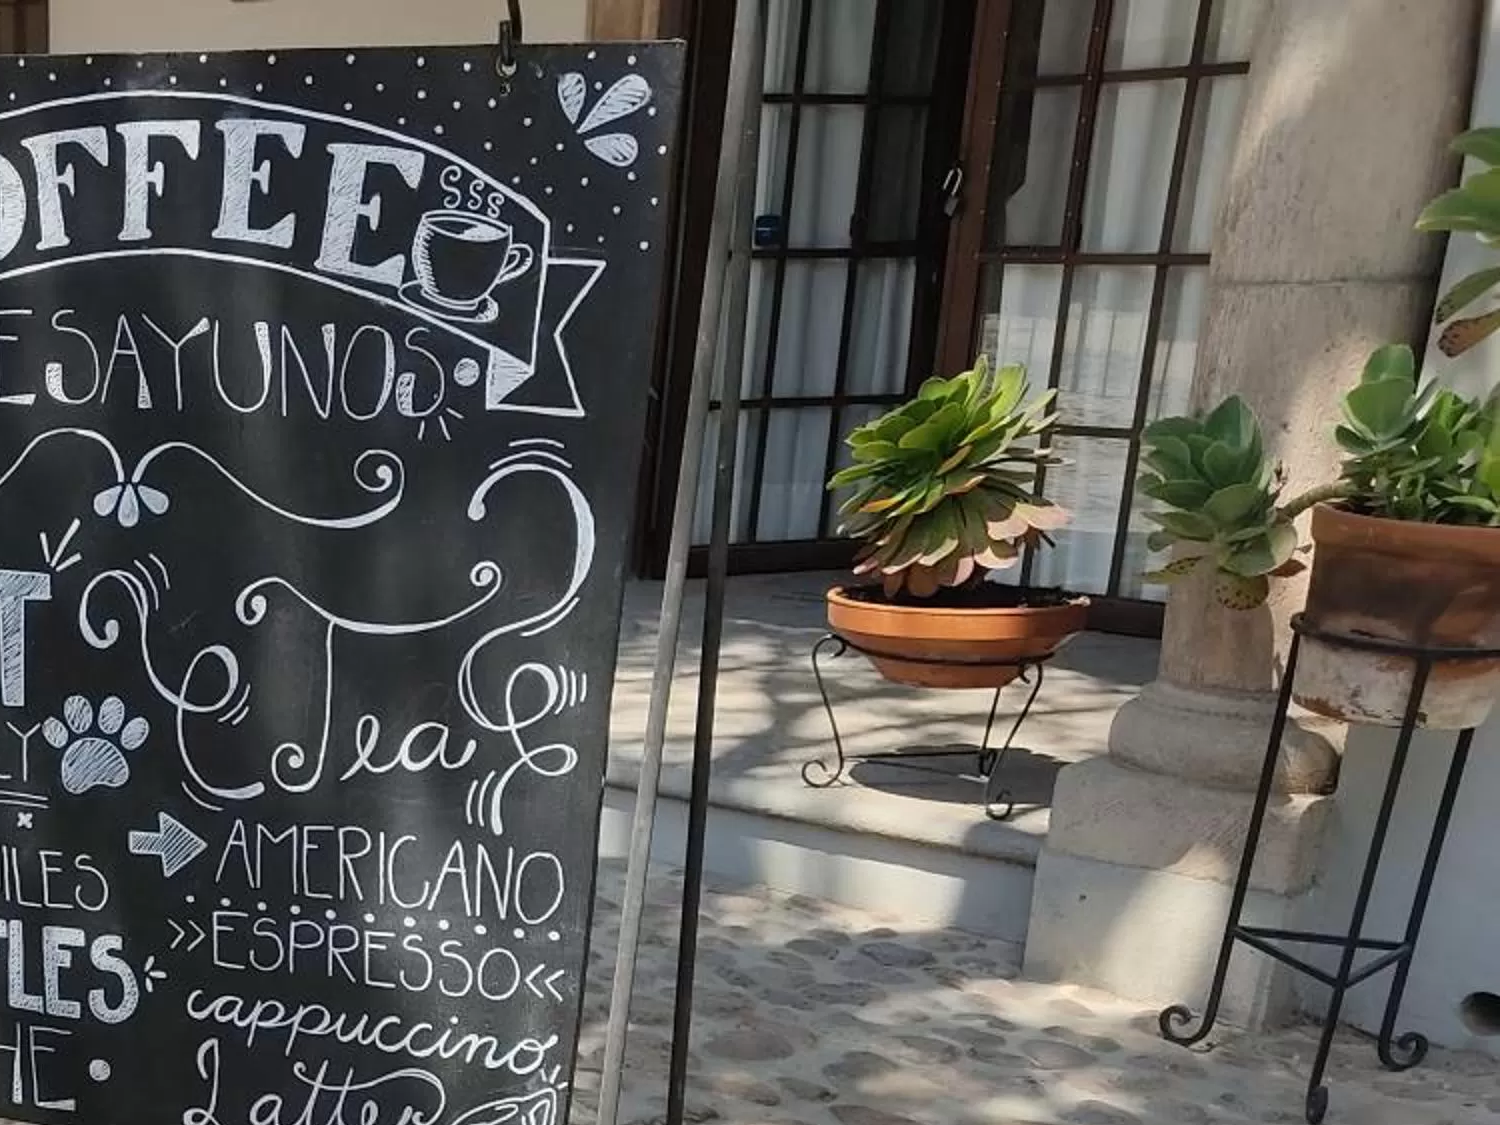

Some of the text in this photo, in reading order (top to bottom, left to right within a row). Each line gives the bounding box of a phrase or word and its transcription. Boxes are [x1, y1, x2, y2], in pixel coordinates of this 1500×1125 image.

[236, 560, 501, 792] Tea
[215, 818, 564, 925] AMERICANO
[212, 909, 521, 1001] ESPRESSO
[186, 988, 559, 1075] cappuccino
